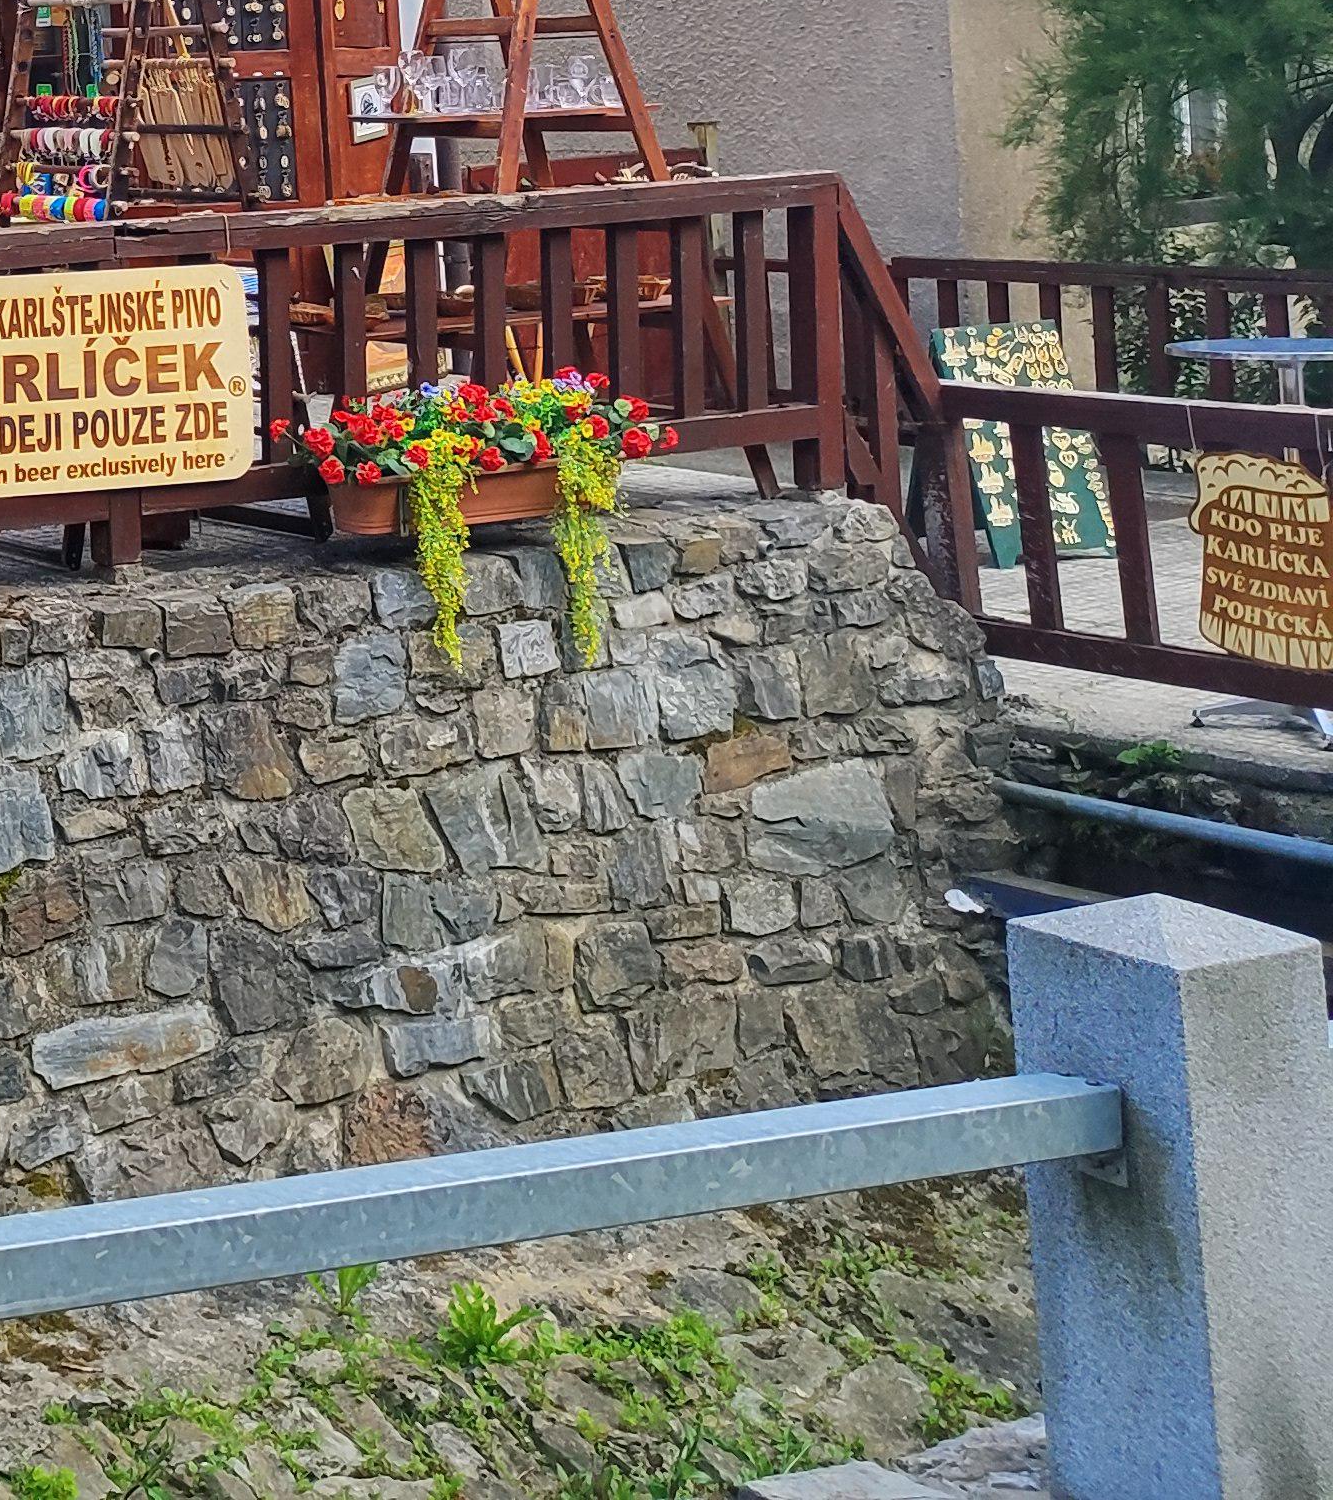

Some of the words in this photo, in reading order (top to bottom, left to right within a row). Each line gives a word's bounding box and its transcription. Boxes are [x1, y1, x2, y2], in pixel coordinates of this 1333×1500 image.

[172, 286, 221, 330] PIVO
[72, 406, 166, 450] POUZE
[175, 401, 229, 442] ZDE
[14, 463, 61, 483] beer
[66, 451, 176, 480] exclusively
[182, 451, 226, 471] here
[1209, 508, 1263, 537] KDO
[1269, 522, 1325, 547] PIJE
[1206, 533, 1331, 579] KARLÍČKA
[1205, 566, 1246, 593] SVÉ
[1249, 579, 1331, 608] ZDRAVÍ
[1212, 593, 1333, 640] POHÝČKÁ
